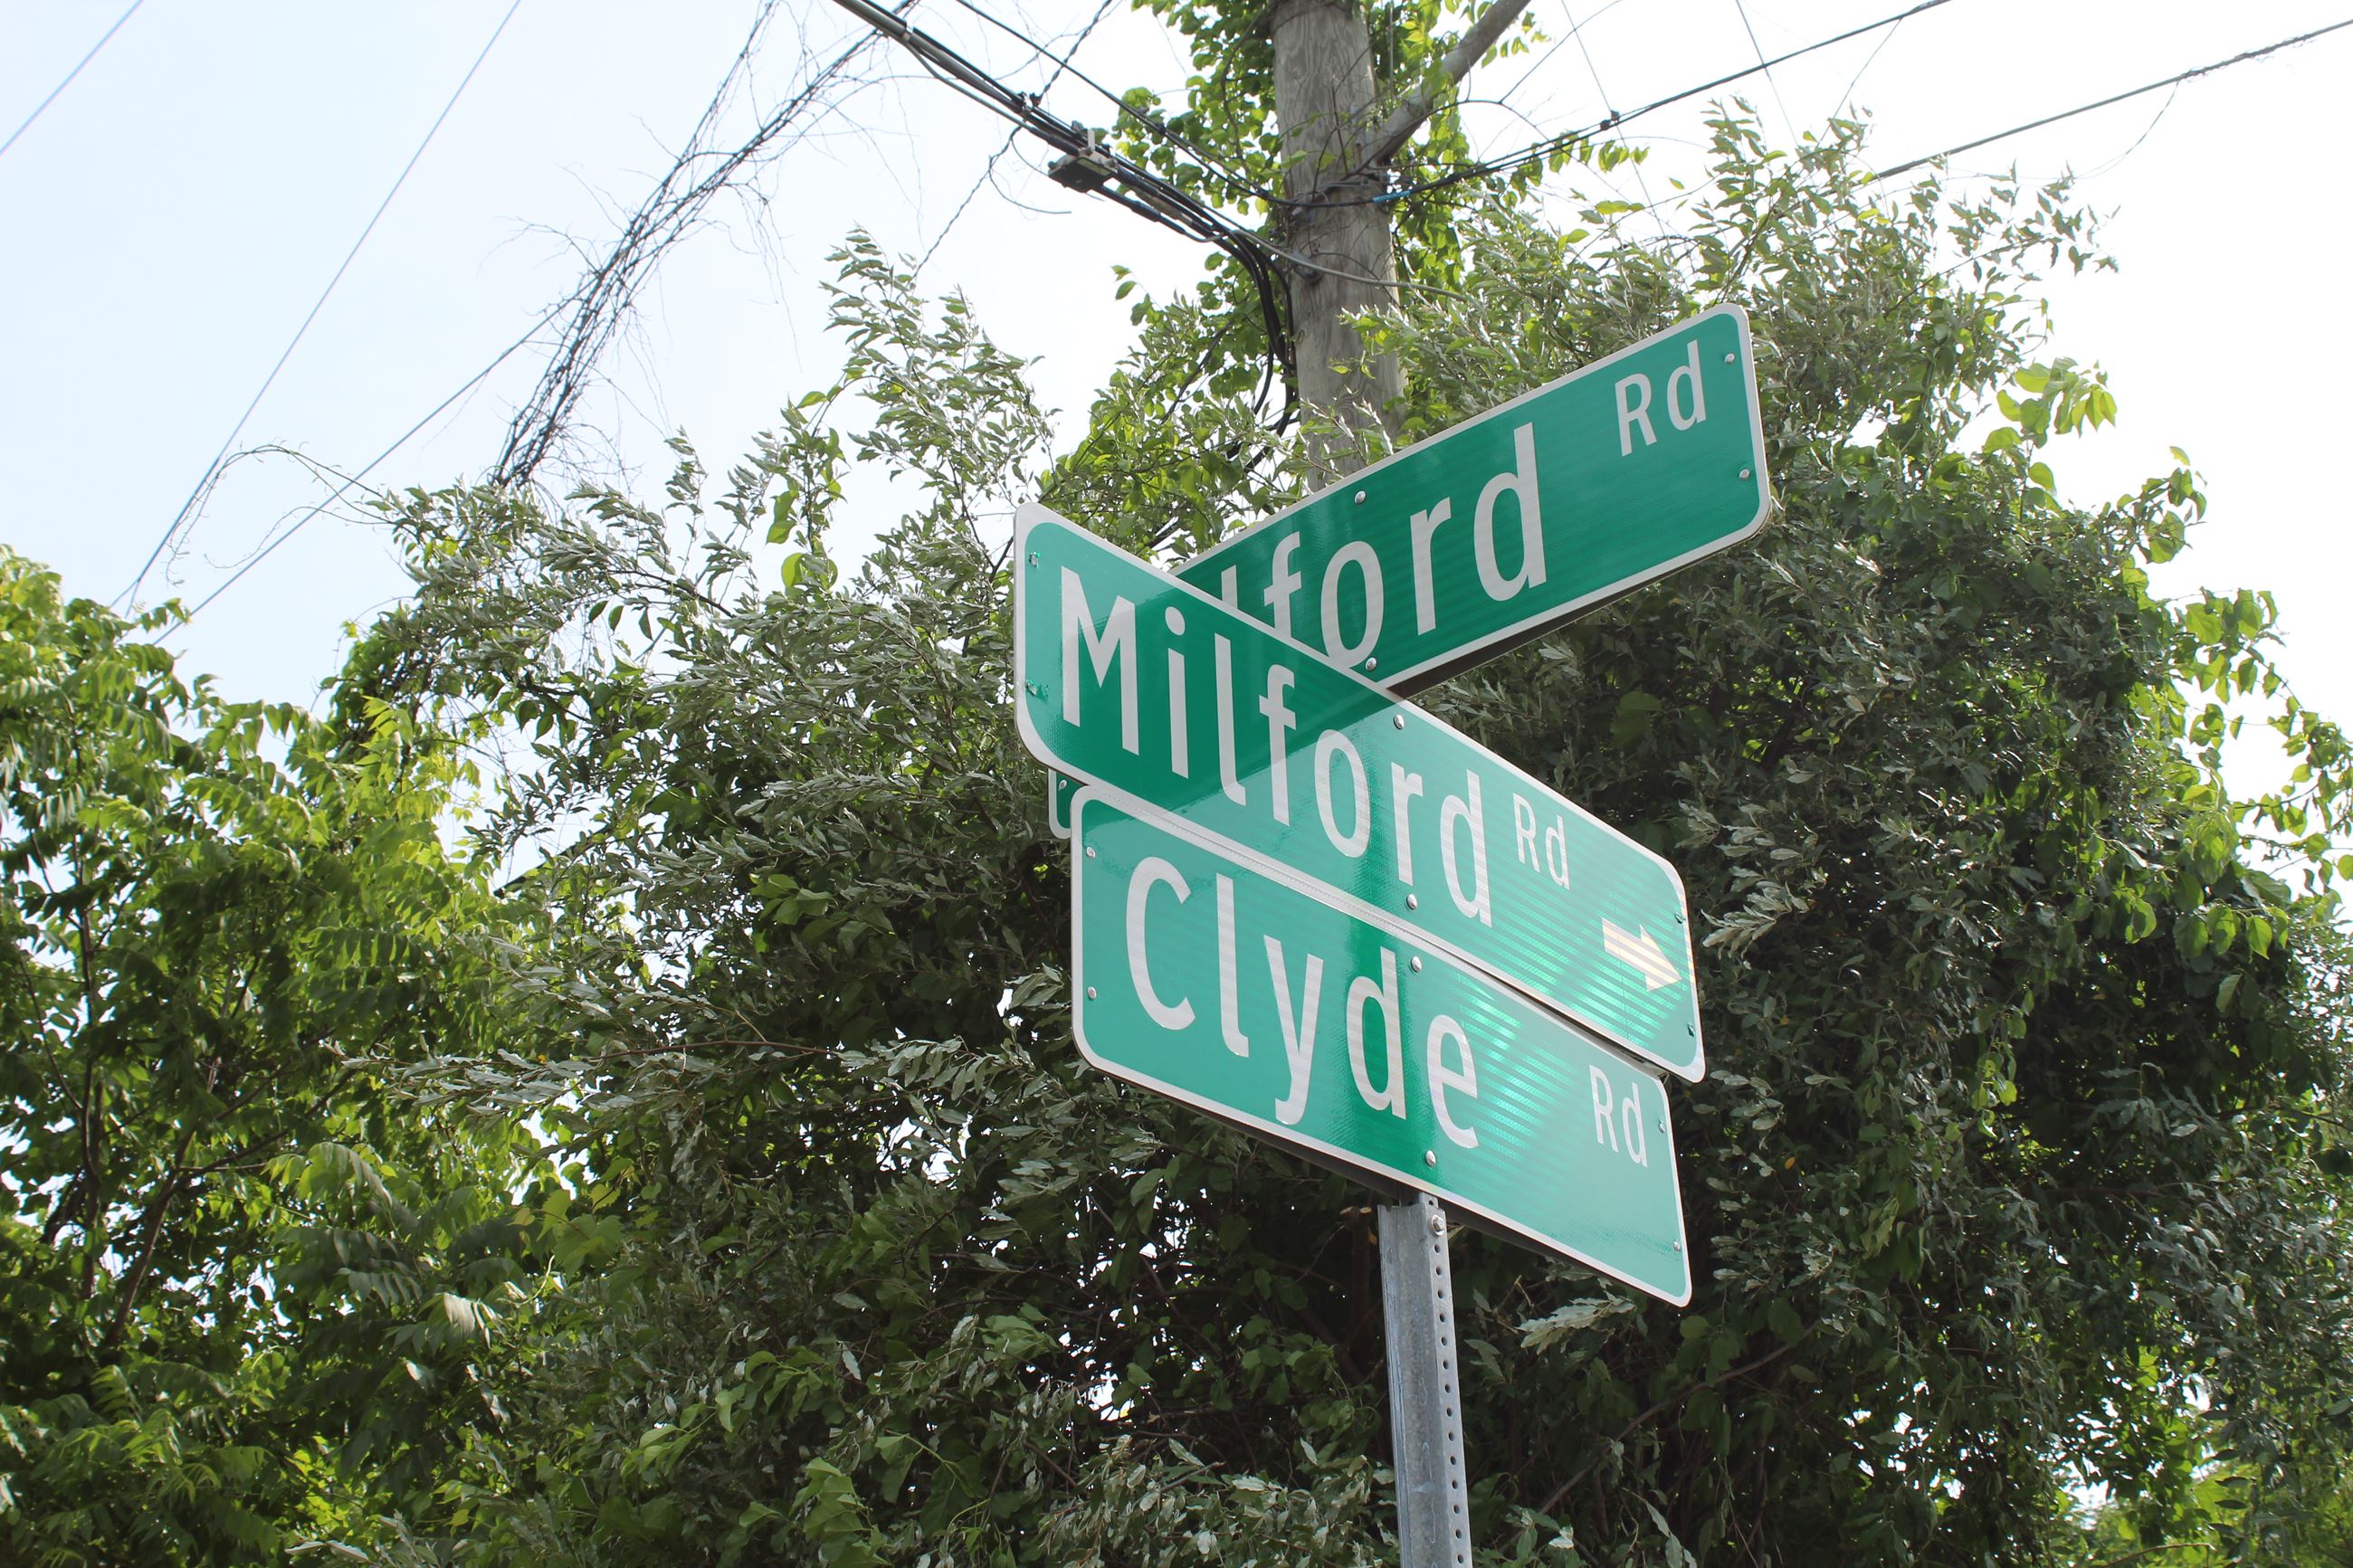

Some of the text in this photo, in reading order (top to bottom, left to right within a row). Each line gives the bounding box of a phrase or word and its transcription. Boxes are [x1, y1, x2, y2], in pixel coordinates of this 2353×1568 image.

[1222, 341, 1707, 668] ford Rd
[1061, 566, 1570, 927] Milford Rd
[1126, 857, 1649, 1166] Clyde Rd
